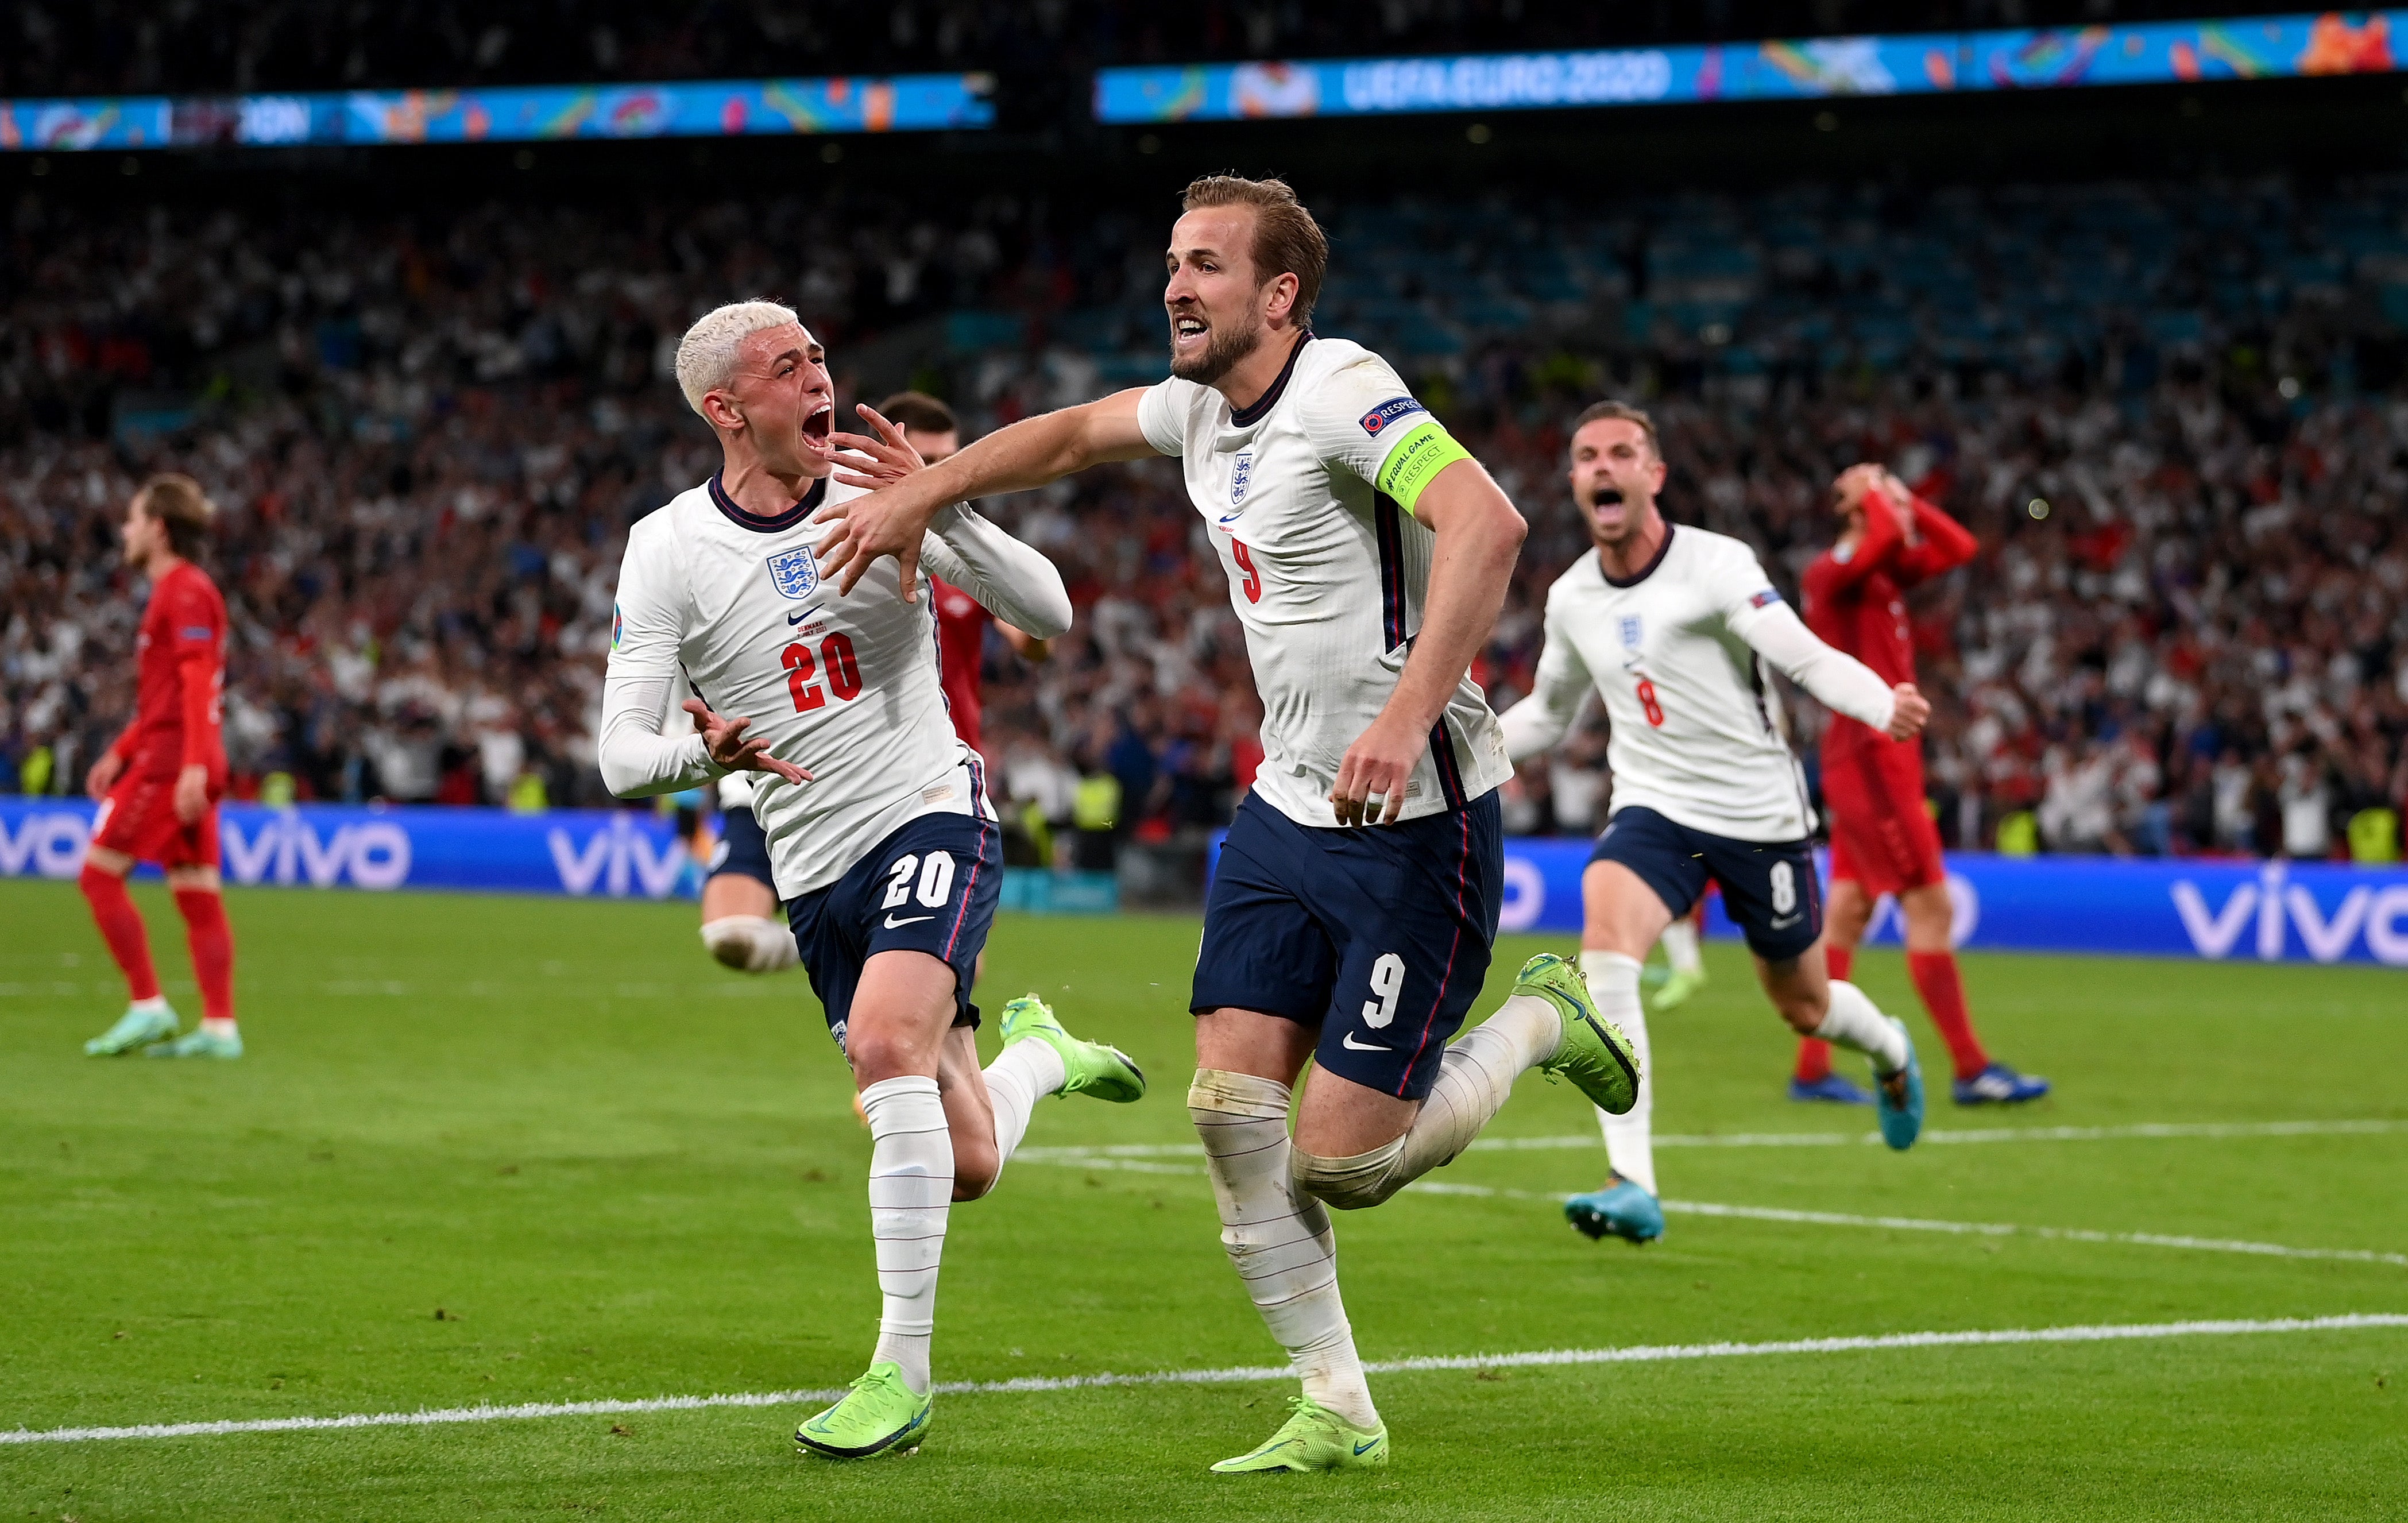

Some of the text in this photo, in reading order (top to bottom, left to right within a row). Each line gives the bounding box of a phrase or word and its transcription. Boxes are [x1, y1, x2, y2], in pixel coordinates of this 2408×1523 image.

[1344, 49, 1671, 110] UEFA EURO 2020
[1385, 434, 1435, 492] #EQUAL GAME
[1404, 446, 1440, 484] RESPECT
[1232, 537, 1262, 605] 9
[797, 621, 823, 632] DENMARK
[780, 631, 863, 713] 20
[1637, 680, 1664, 727] 8
[221, 804, 412, 890] vivo
[548, 809, 702, 896] viv
[880, 850, 956, 910] 20
[1769, 859, 1797, 915] 8
[1362, 953, 1406, 1029] 9
